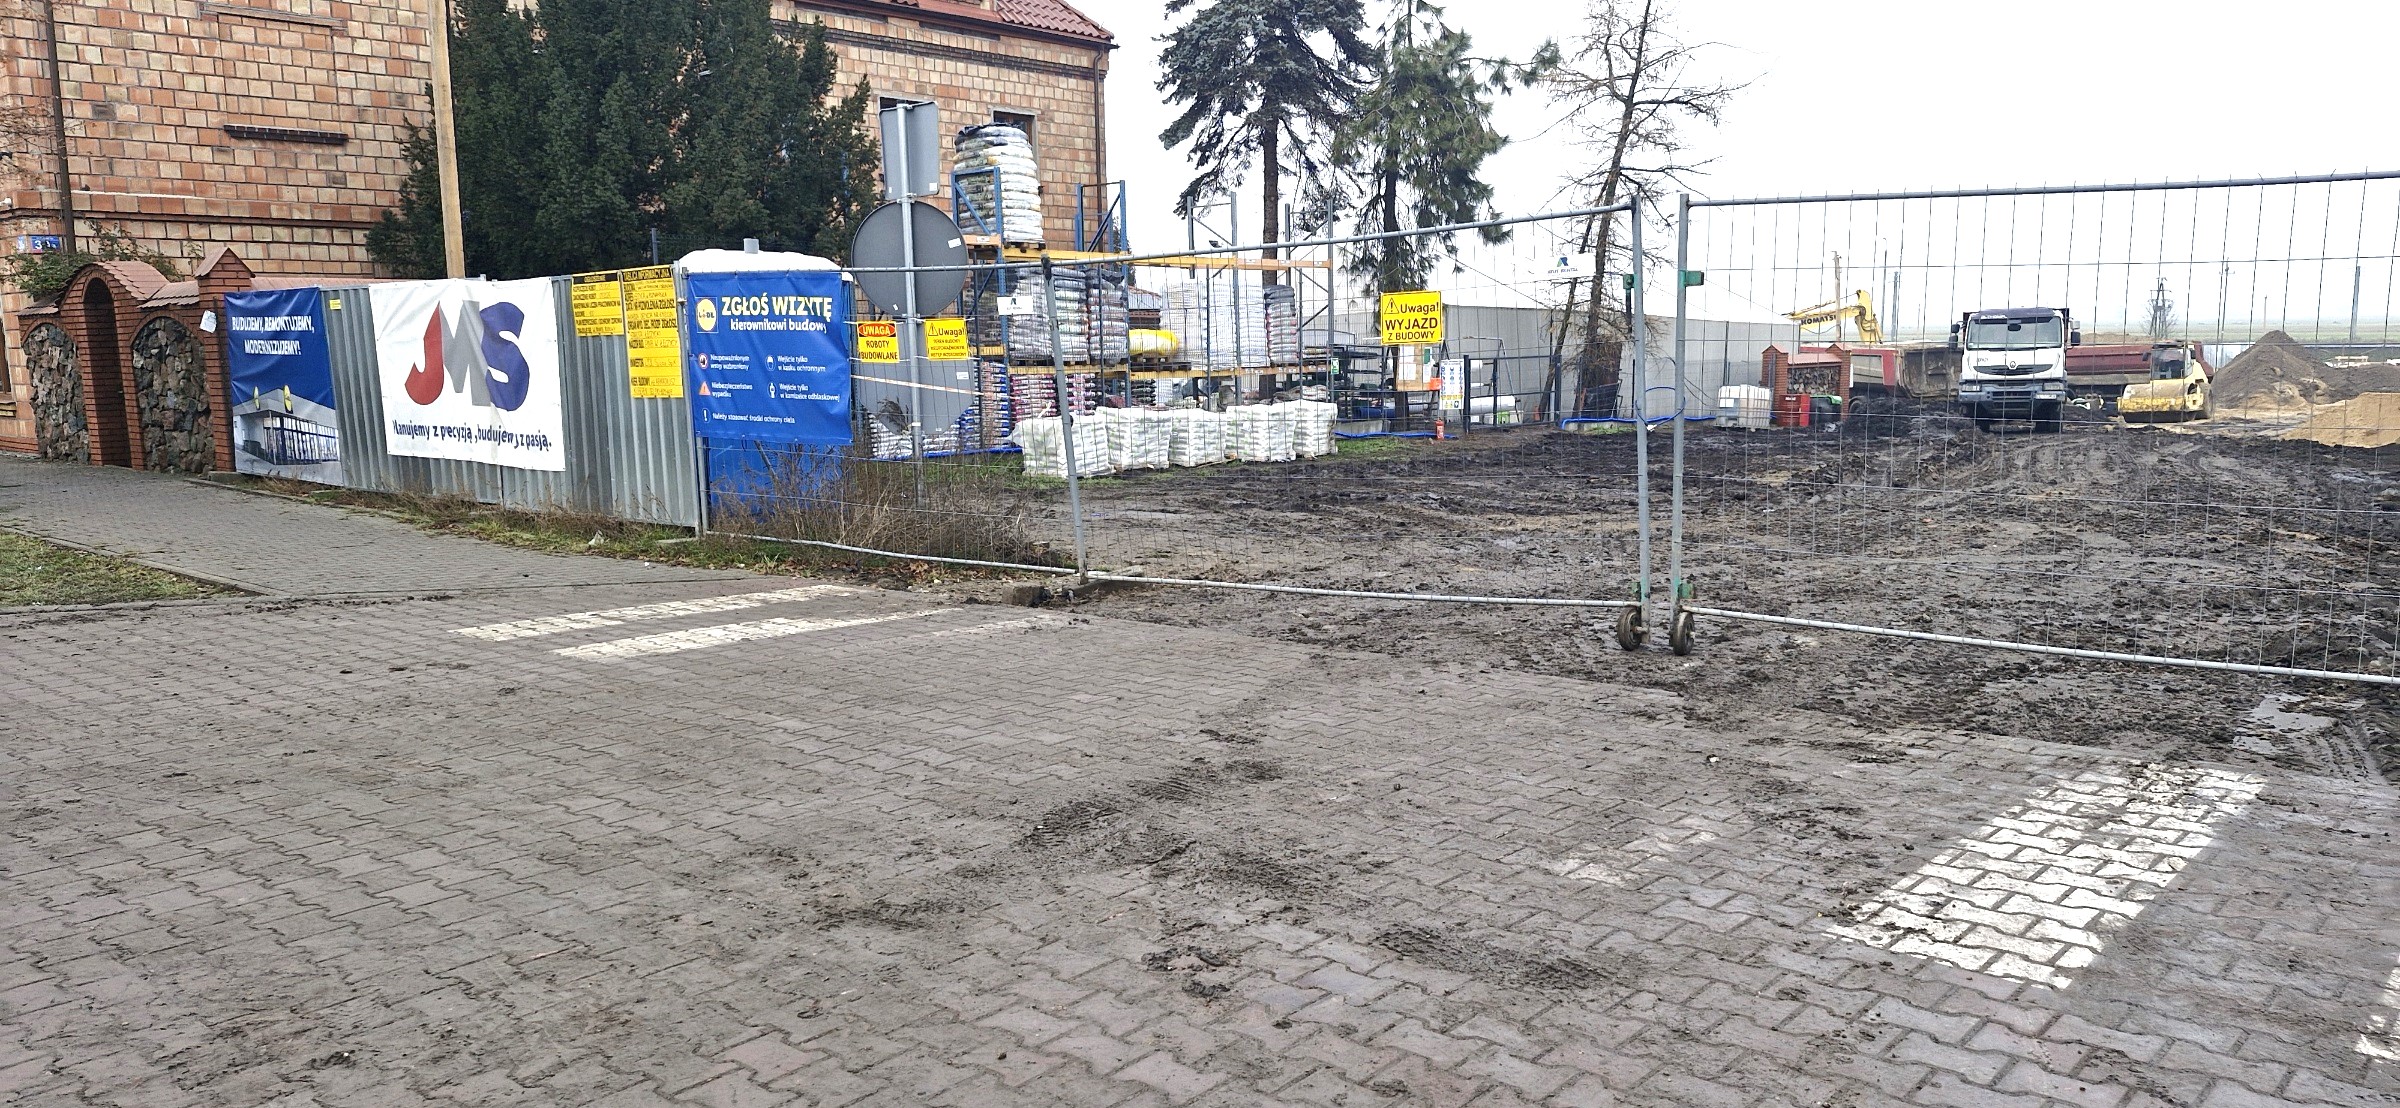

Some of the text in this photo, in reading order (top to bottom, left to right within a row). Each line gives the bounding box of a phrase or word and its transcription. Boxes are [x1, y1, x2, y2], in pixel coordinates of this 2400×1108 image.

[721, 292, 832, 322] ZGŁOŚ WIZYTĘ
[1400, 302, 1439, 315] Uwaga!
[730, 319, 827, 334] kierownikowi budowy
[1385, 317, 1438, 331] WYJAZD
[863, 325, 891, 336] UWAGA
[1388, 331, 1435, 341] Z BUDOWY
[866, 340, 890, 349] ROBOTY
[404, 300, 530, 411] JMS
[861, 351, 898, 360] BUDOWLANE
[432, 425, 439, 437] z
